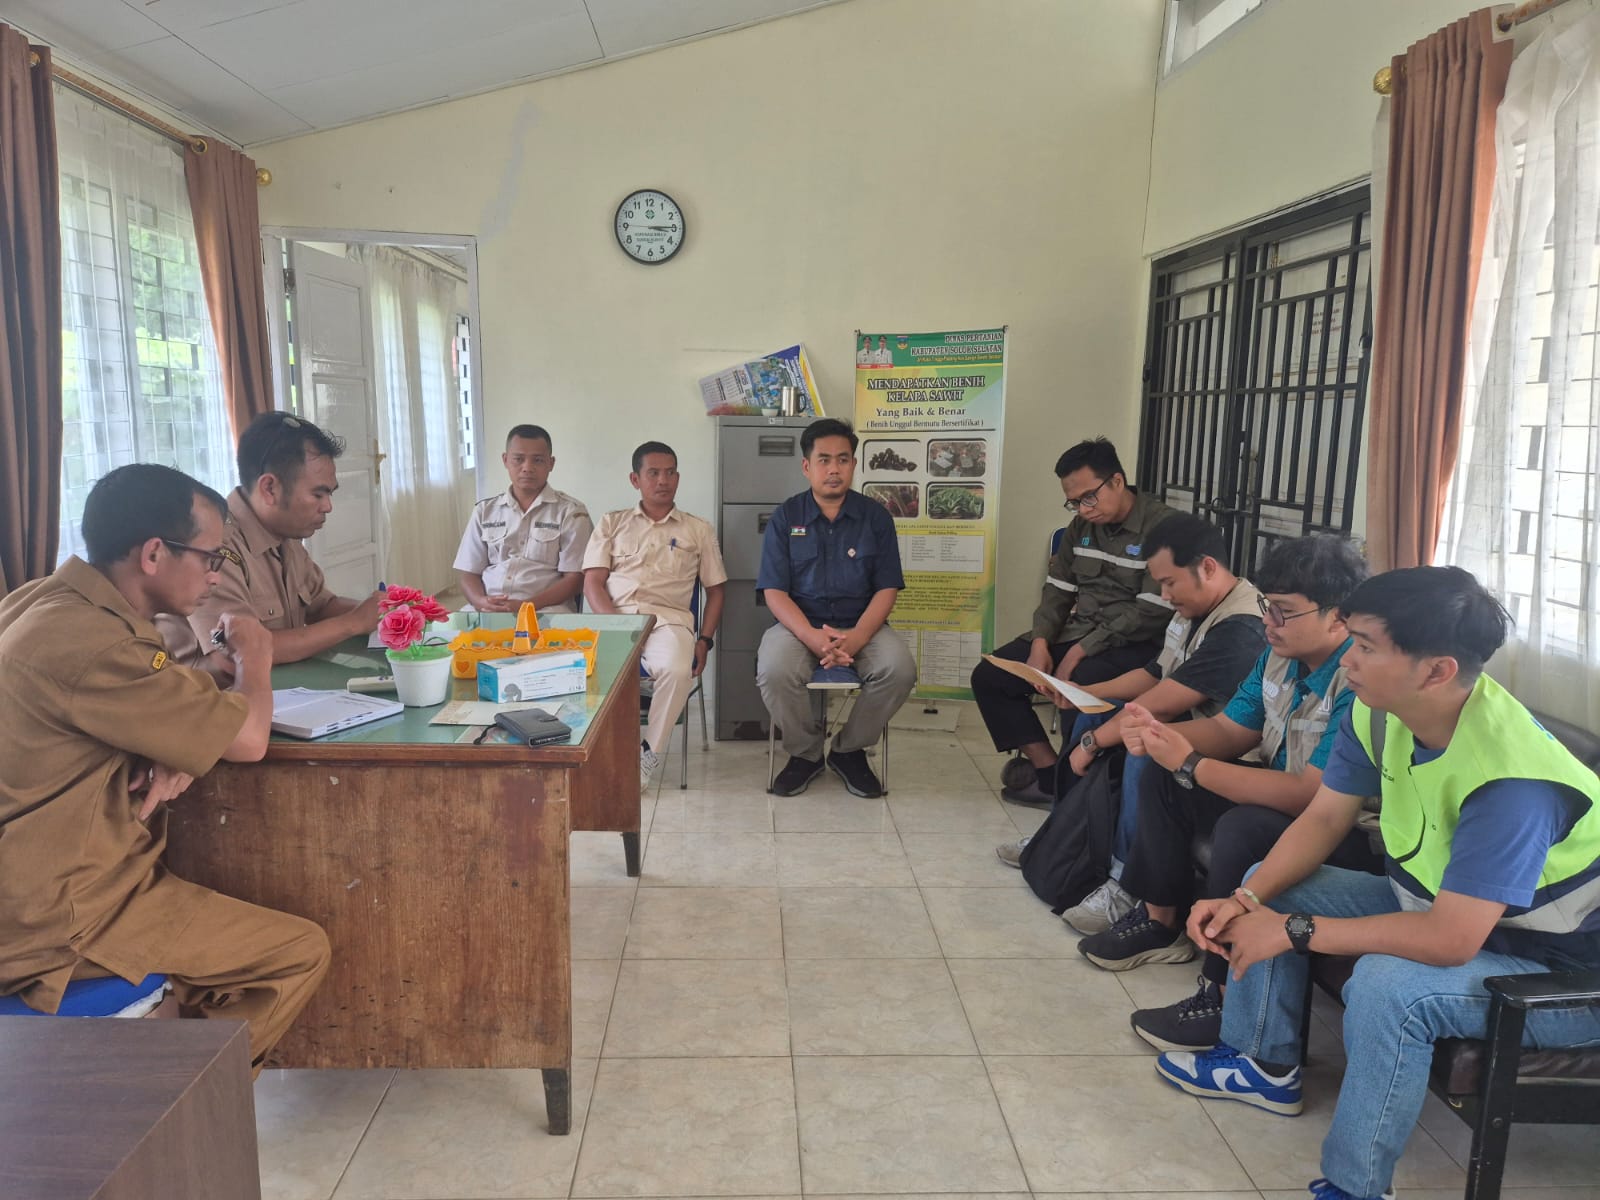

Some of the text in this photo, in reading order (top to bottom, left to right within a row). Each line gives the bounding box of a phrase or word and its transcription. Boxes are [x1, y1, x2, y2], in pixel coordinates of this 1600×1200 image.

[633, 201, 641, 210] 11
[645, 199, 654, 207] 12
[660, 202, 664, 211] 1
[625, 211, 634, 219] 10
[668, 212, 674, 220] 2
[623, 223, 629, 231] 9
[671, 224, 677, 233] 3
[626, 235, 632, 244] 8
[667, 236, 673, 245] 4
[636, 245, 641, 253] 7
[659, 245, 665, 254] 5
[911, 345, 949, 356] KABUPATEN
[867, 376, 985, 390] MENDAPATKAN BENIH
[887, 389, 965, 402] KELAPA SAWIT
[876, 407, 966, 418] Yang Baik & Benar
